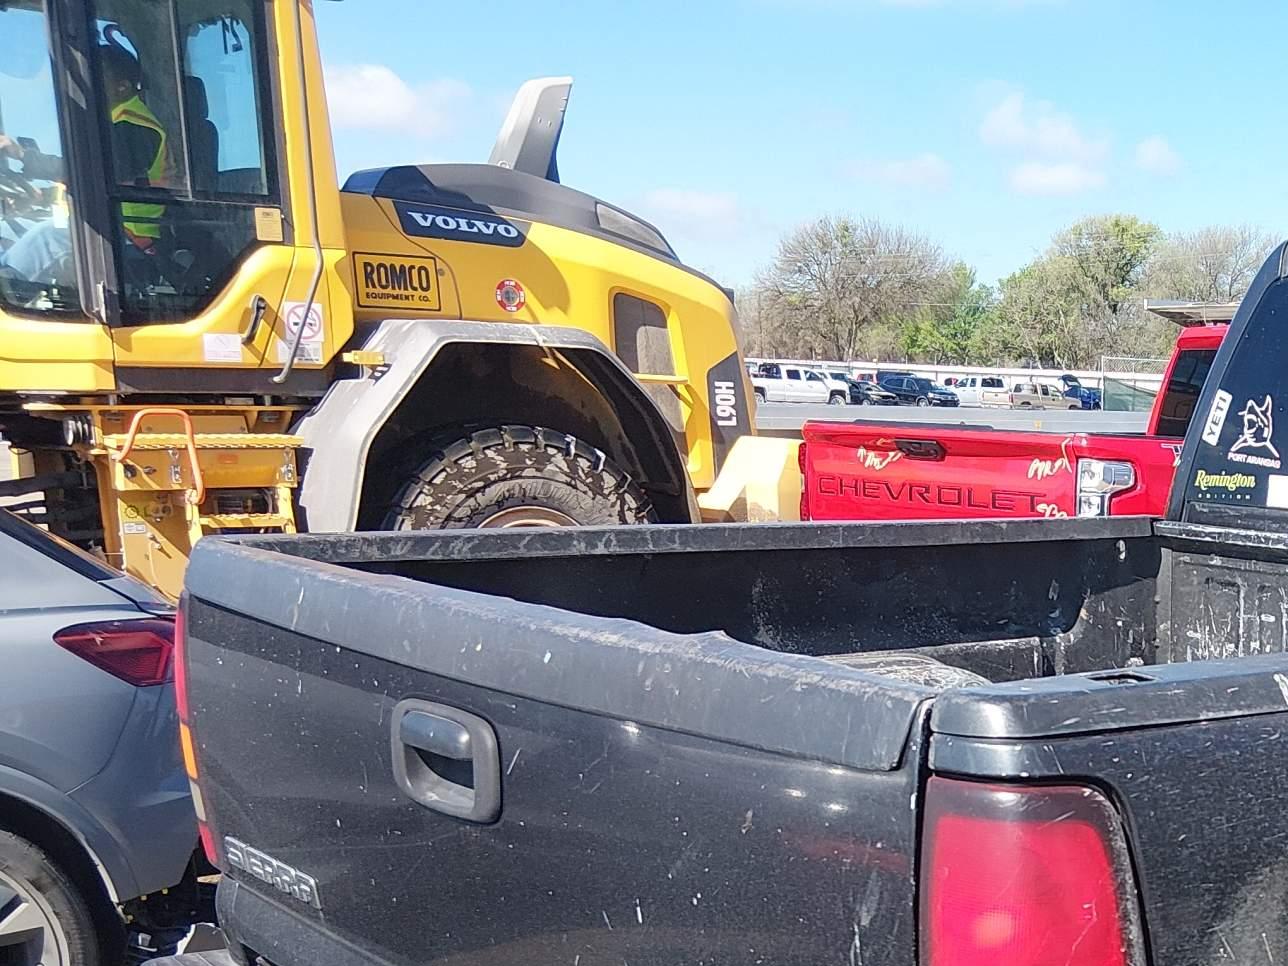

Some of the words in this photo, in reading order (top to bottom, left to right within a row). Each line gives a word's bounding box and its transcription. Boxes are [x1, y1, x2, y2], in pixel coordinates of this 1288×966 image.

[407, 211, 519, 238] VOLVO
[363, 261, 431, 292] ROMCO
[366, 291, 415, 302] EQUIPMENT
[714, 381, 737, 426] L90H
[1207, 396, 1227, 438] YETI
[817, 476, 1046, 514] CHEVROLET
[1194, 470, 1256, 491] Remington
[225, 836, 321, 910] SIERRA
